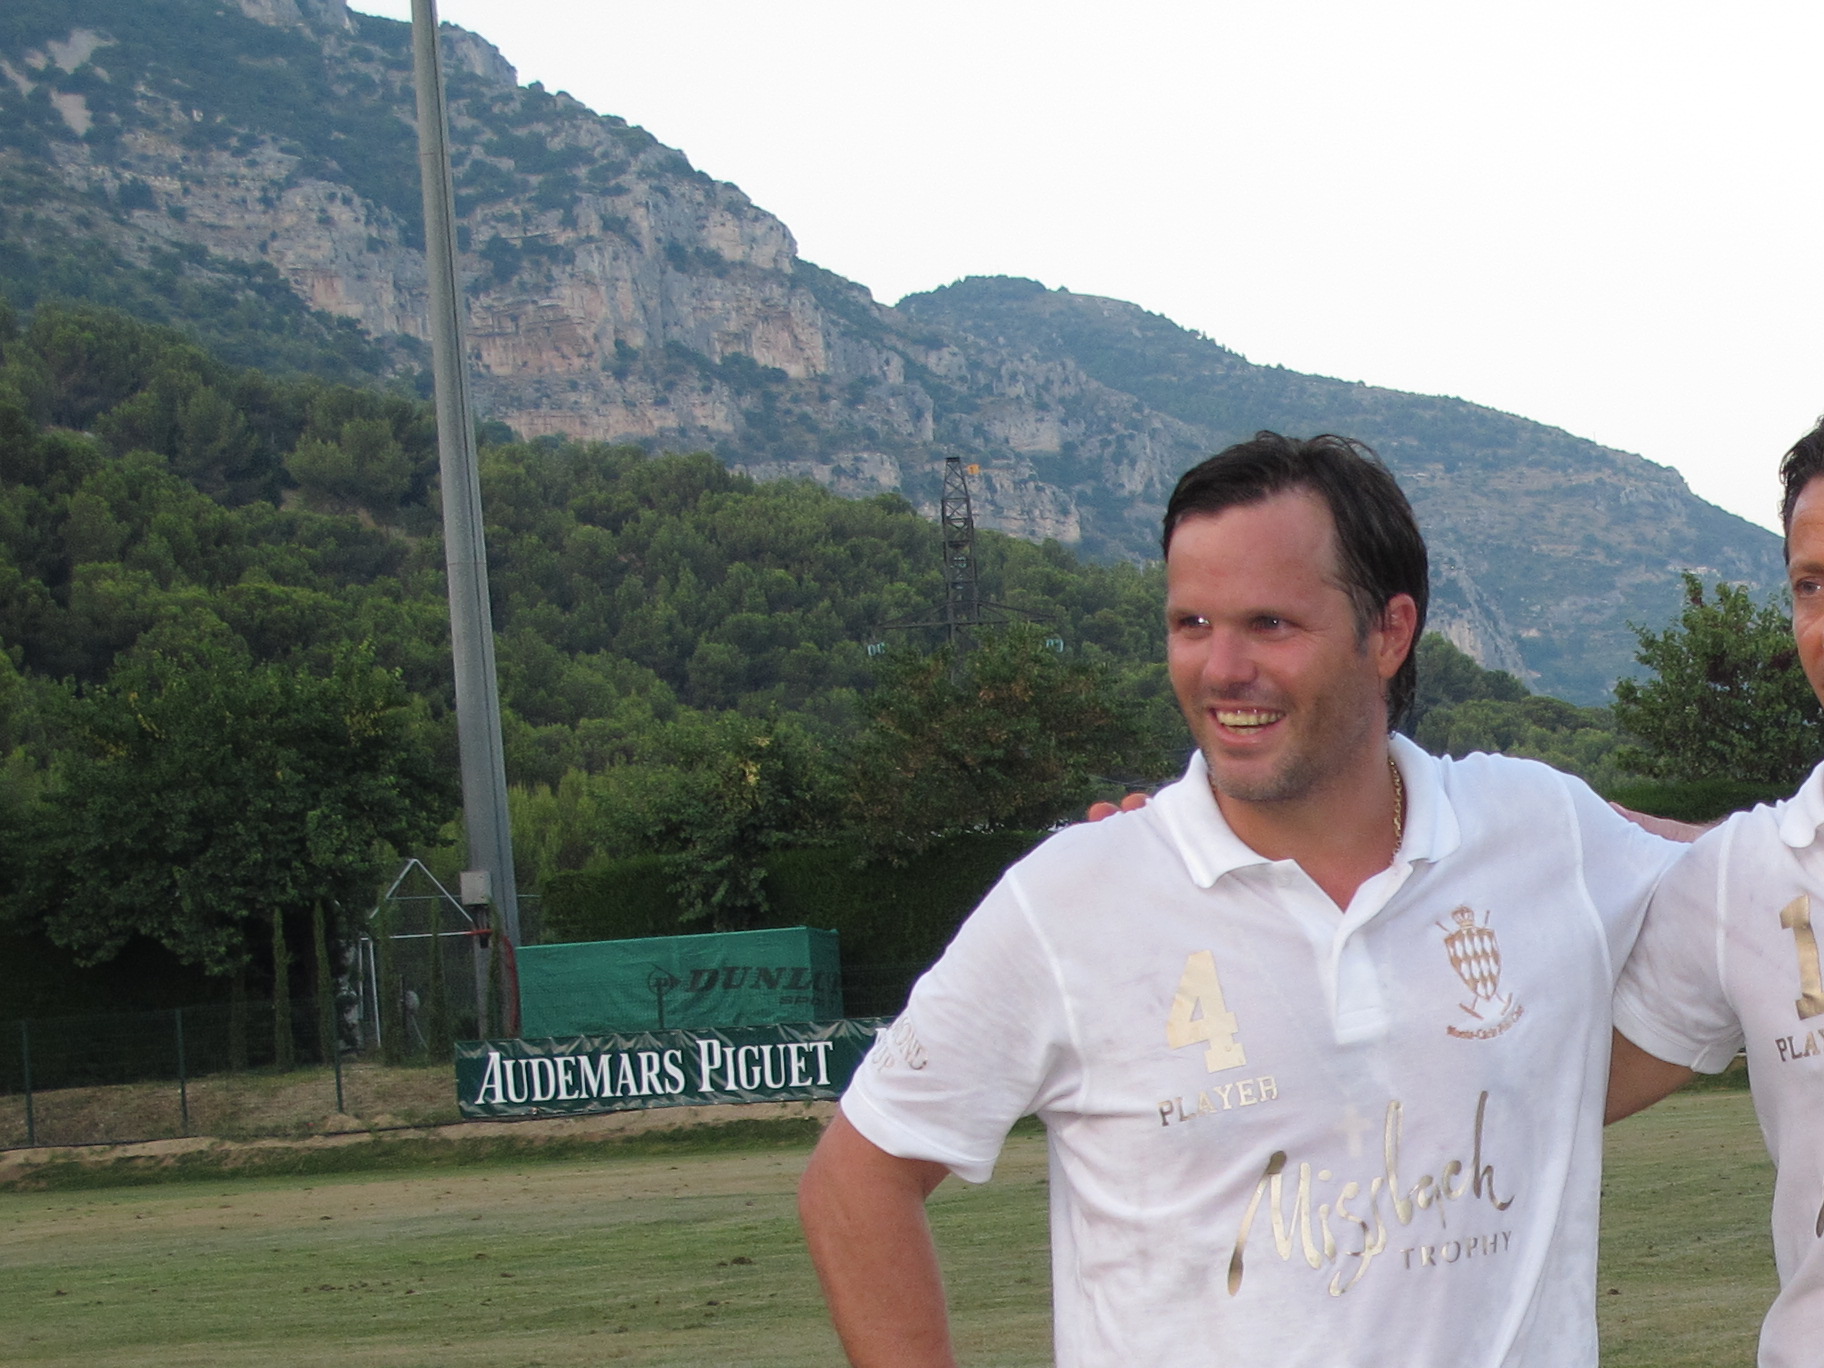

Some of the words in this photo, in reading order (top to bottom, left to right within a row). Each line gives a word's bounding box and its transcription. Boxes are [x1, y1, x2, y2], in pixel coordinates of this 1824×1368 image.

[1166, 948, 1247, 1074] 4
[474, 1049, 687, 1105] AUDEMARS
[695, 1038, 834, 1093] PIGUET
[1157, 1075, 1279, 1127] PLAYER
[1400, 1230, 1513, 1270] TROPHY
